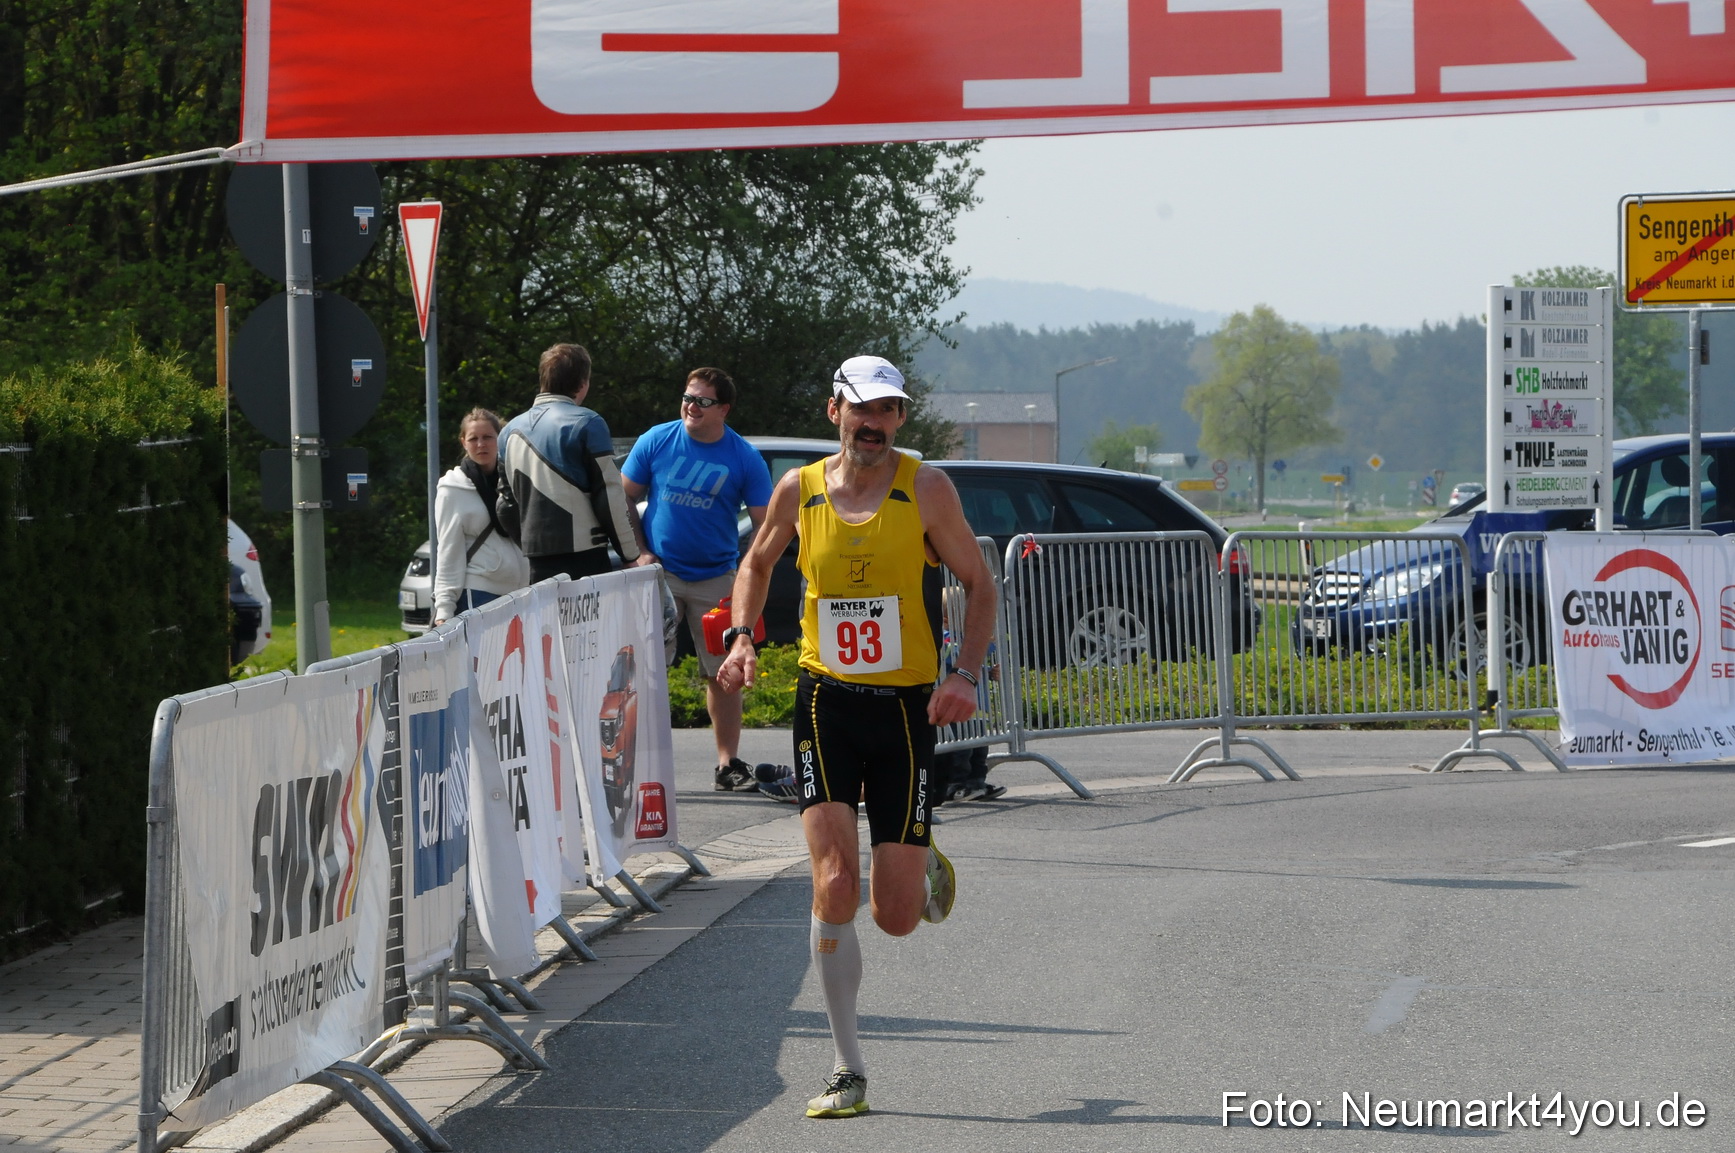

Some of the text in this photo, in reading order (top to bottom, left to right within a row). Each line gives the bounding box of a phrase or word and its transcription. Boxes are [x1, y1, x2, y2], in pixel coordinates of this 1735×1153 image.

[1654, 250, 1678, 262] am
[1635, 277, 1661, 290] Kreis
[1666, 275, 1717, 289] Neumarkt
[1541, 291, 1588, 307] HOLZAMMER
[1542, 328, 1589, 344] HOLZAMMER
[1516, 367, 1540, 395] SHB
[1515, 441, 1555, 468] THULE
[830, 601, 867, 611] MEYER
[1562, 590, 1685, 626] GERHART &
[837, 620, 883, 666] 93
[1620, 628, 1689, 665] JÄNIG
[646, 811, 662, 821] KIA
